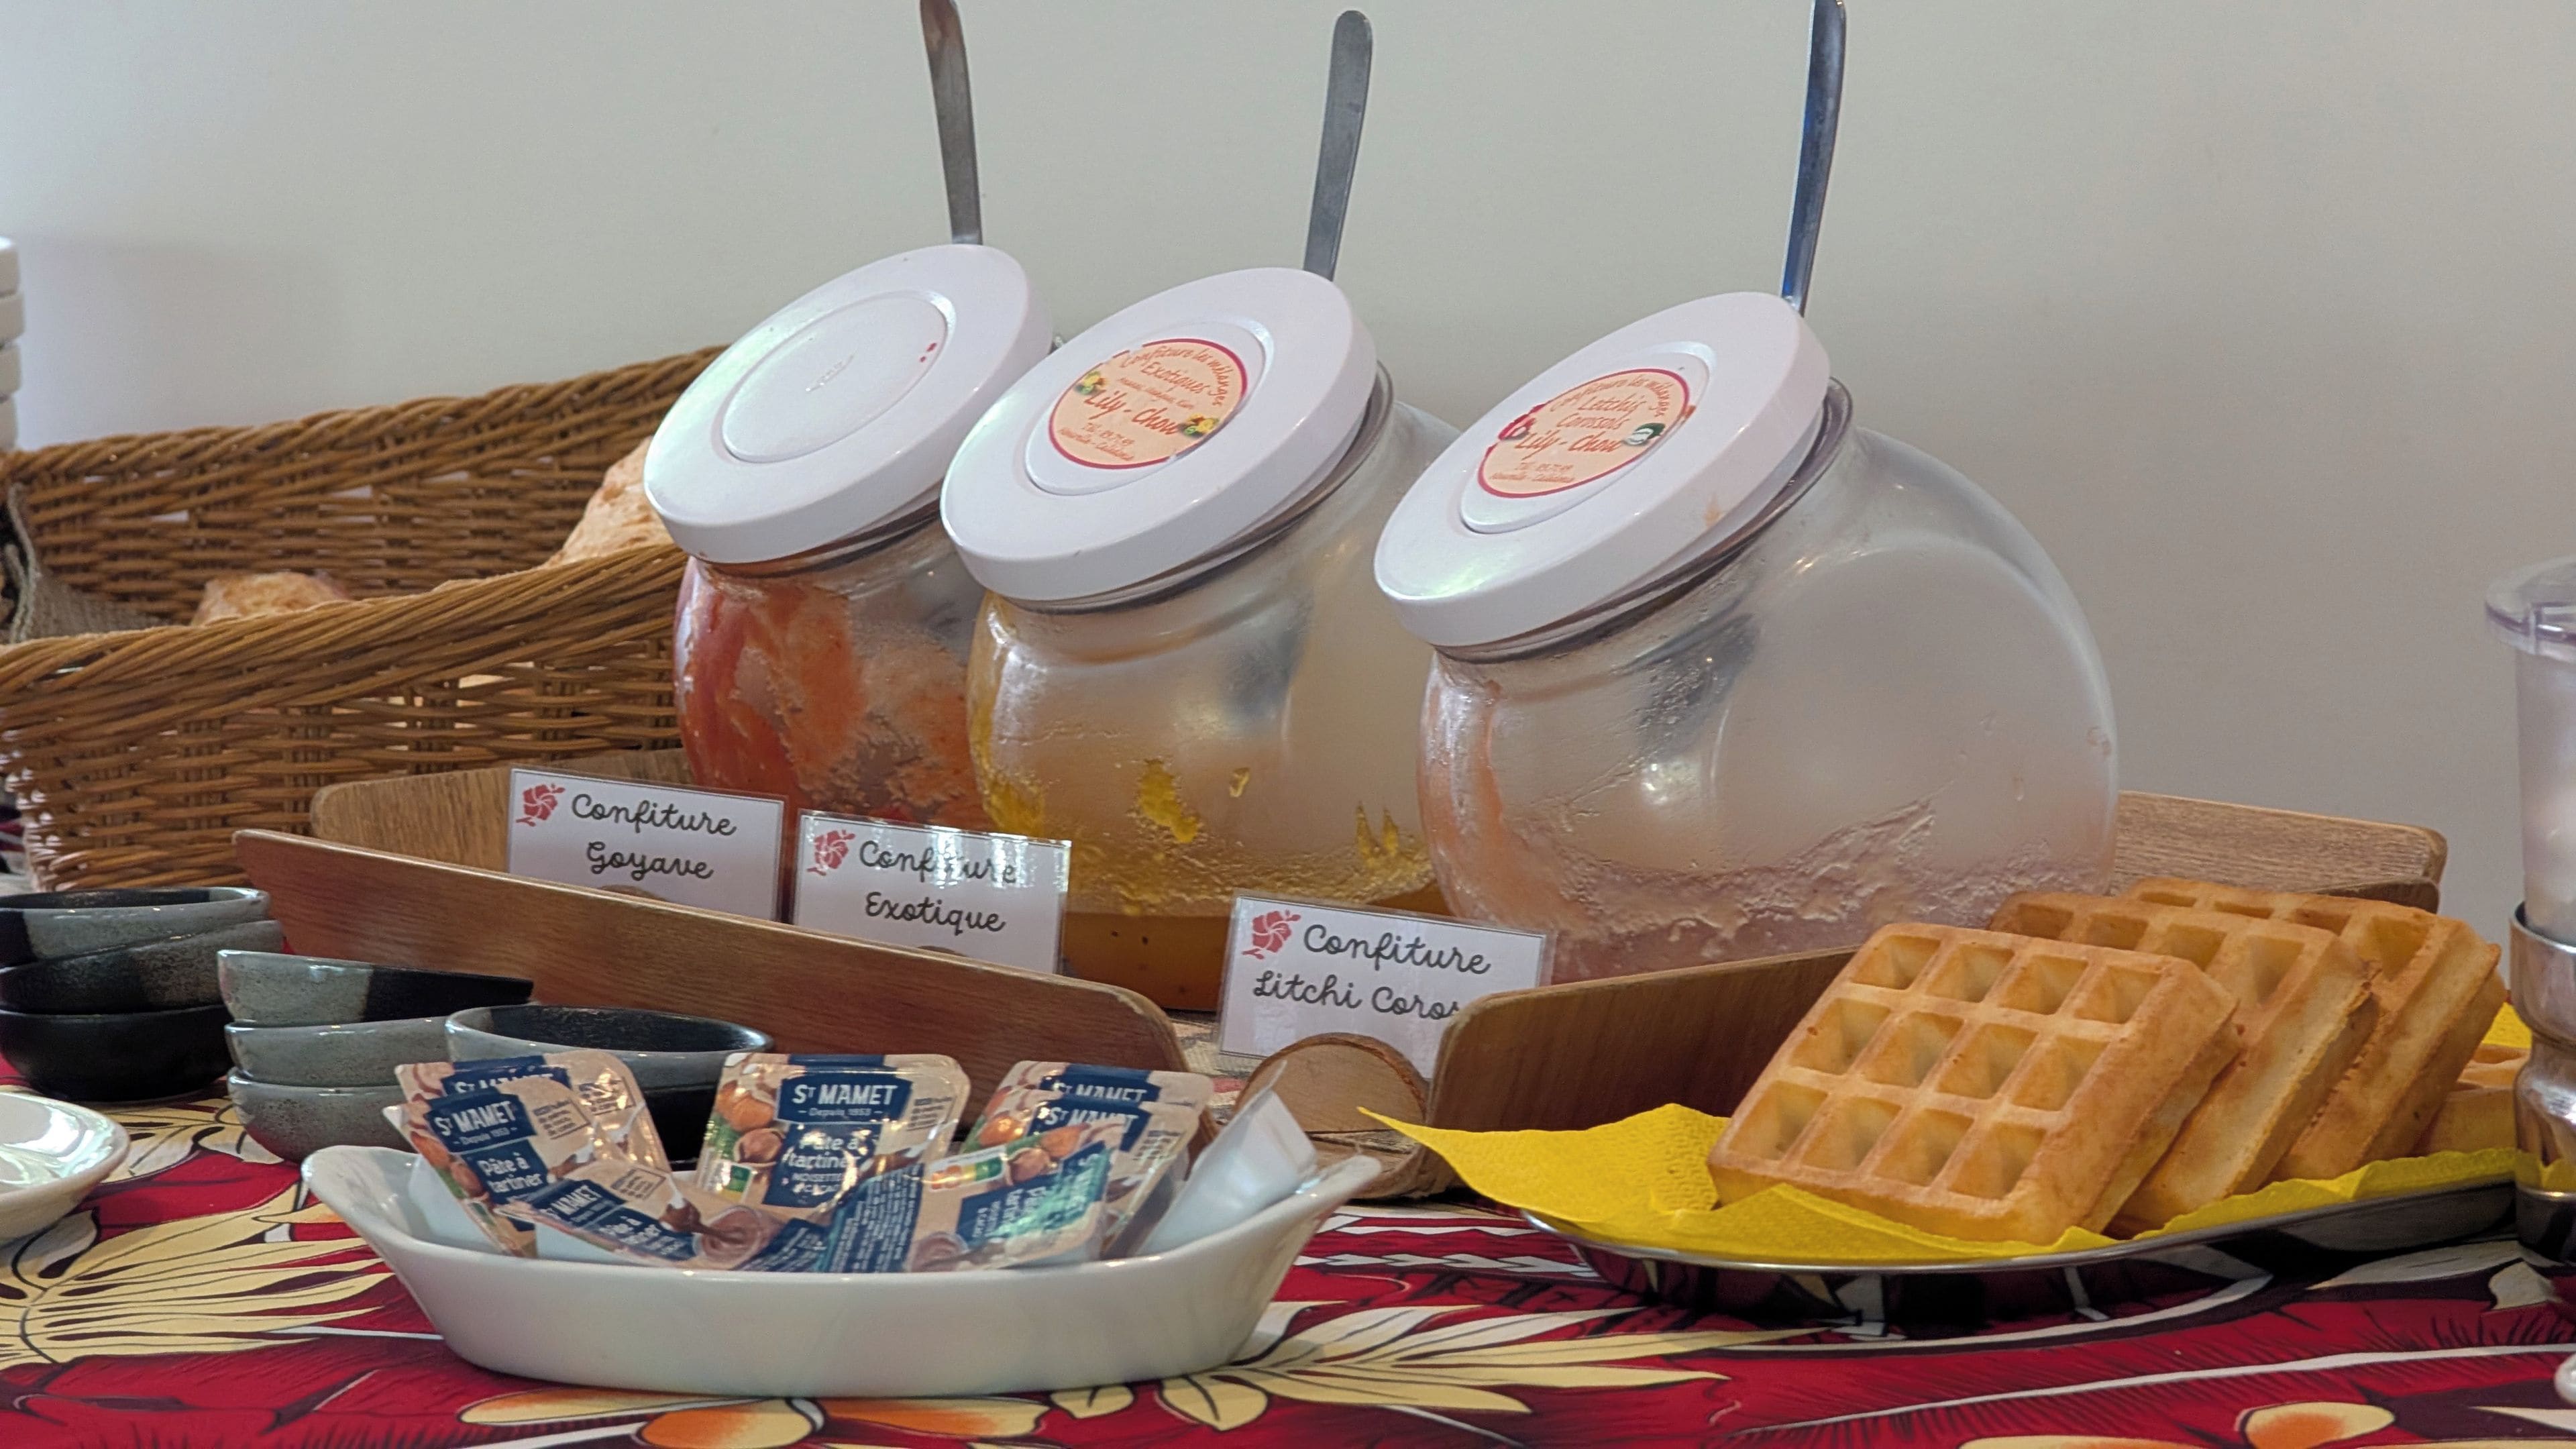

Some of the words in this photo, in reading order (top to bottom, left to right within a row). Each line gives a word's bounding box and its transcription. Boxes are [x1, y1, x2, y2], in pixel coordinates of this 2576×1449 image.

[1141, 362, 1210, 393] Exotiques
[1084, 390, 1127, 421] Lily
[572, 794, 737, 837] Confiture
[586, 841, 714, 881] Goyave
[859, 840, 1018, 884] Confure
[865, 892, 1007, 936] Exotique
[1303, 924, 1491, 975] Confiture
[1253, 970, 1363, 1010] Litchi
[817, 1083, 898, 1105] MAMET
[451, 1101, 516, 1132] MAMET
[477, 1158, 517, 1177] Pâte
[513, 1152, 530, 1170] à
[788, 1150, 861, 1169] tartine
[486, 1173, 544, 1193] tartiner
